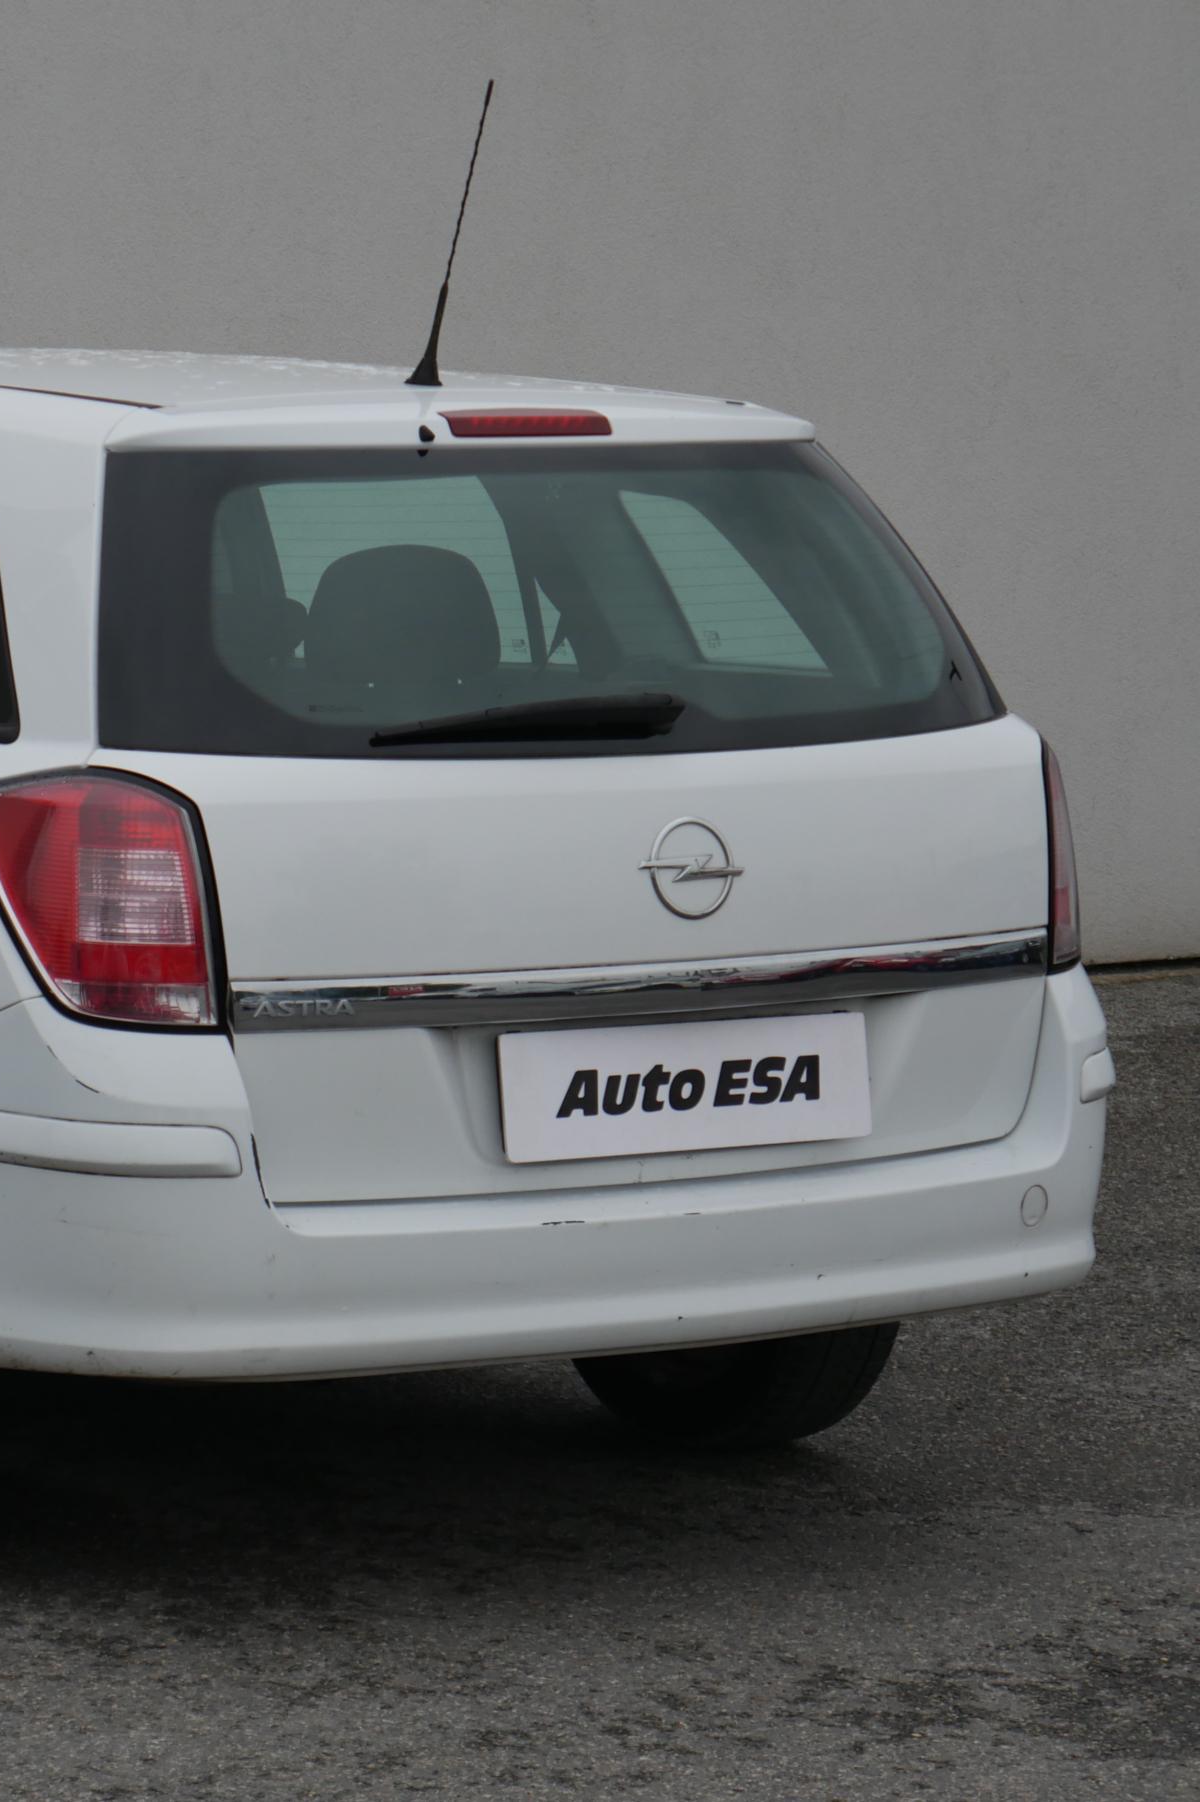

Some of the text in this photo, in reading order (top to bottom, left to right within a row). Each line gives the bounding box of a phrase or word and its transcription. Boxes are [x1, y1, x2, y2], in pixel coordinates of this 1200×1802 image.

[252, 998, 355, 1018] ASTRA
[556, 1055, 819, 1118] Auto ESA
